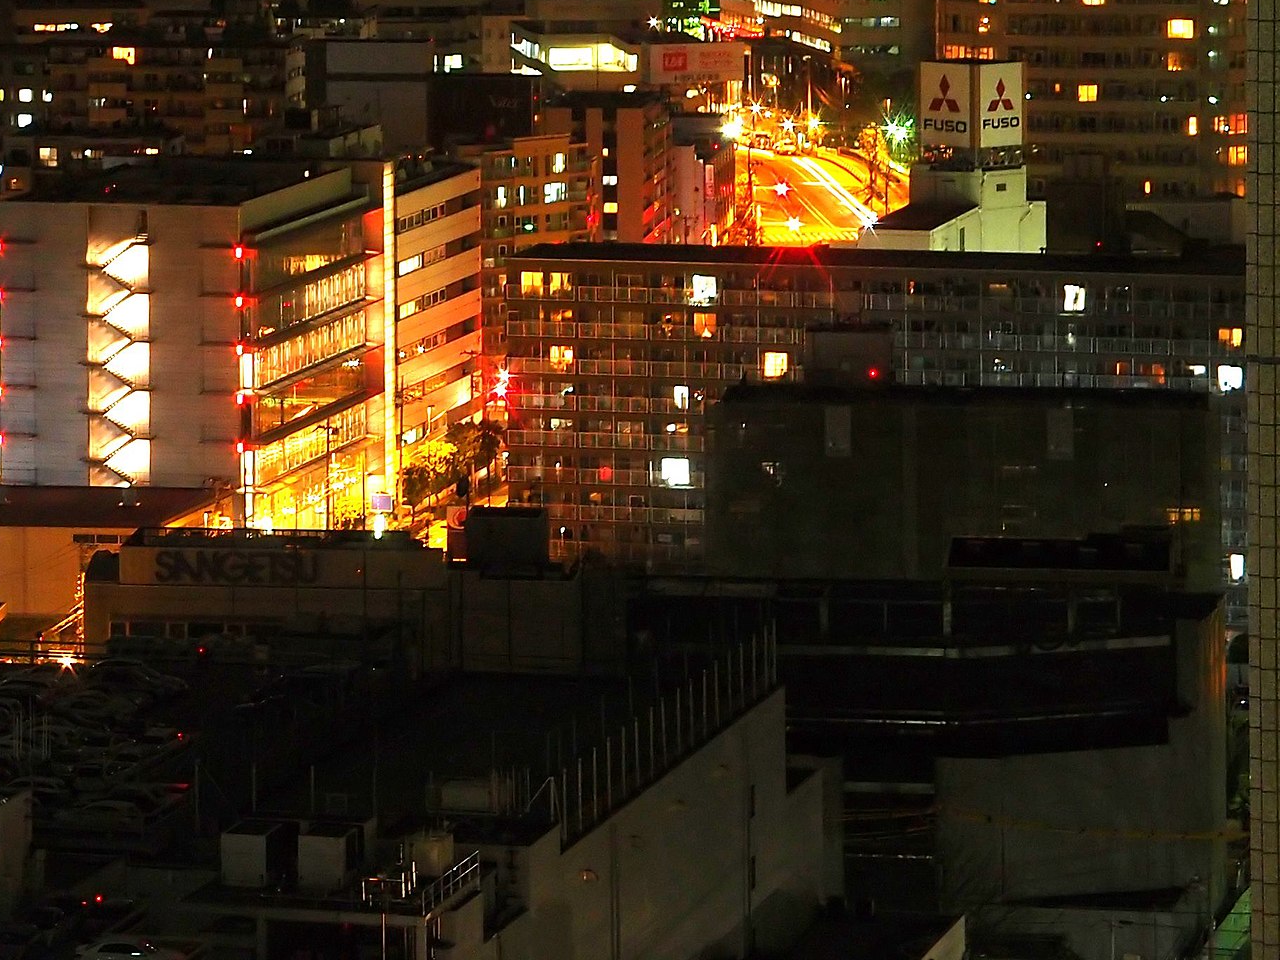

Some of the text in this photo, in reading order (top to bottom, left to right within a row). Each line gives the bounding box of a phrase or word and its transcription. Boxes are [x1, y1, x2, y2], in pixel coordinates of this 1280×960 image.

[923, 118, 967, 133] FUSO
[982, 117, 1020, 130] FUSO
[154, 550, 319, 582] SANGETSU
